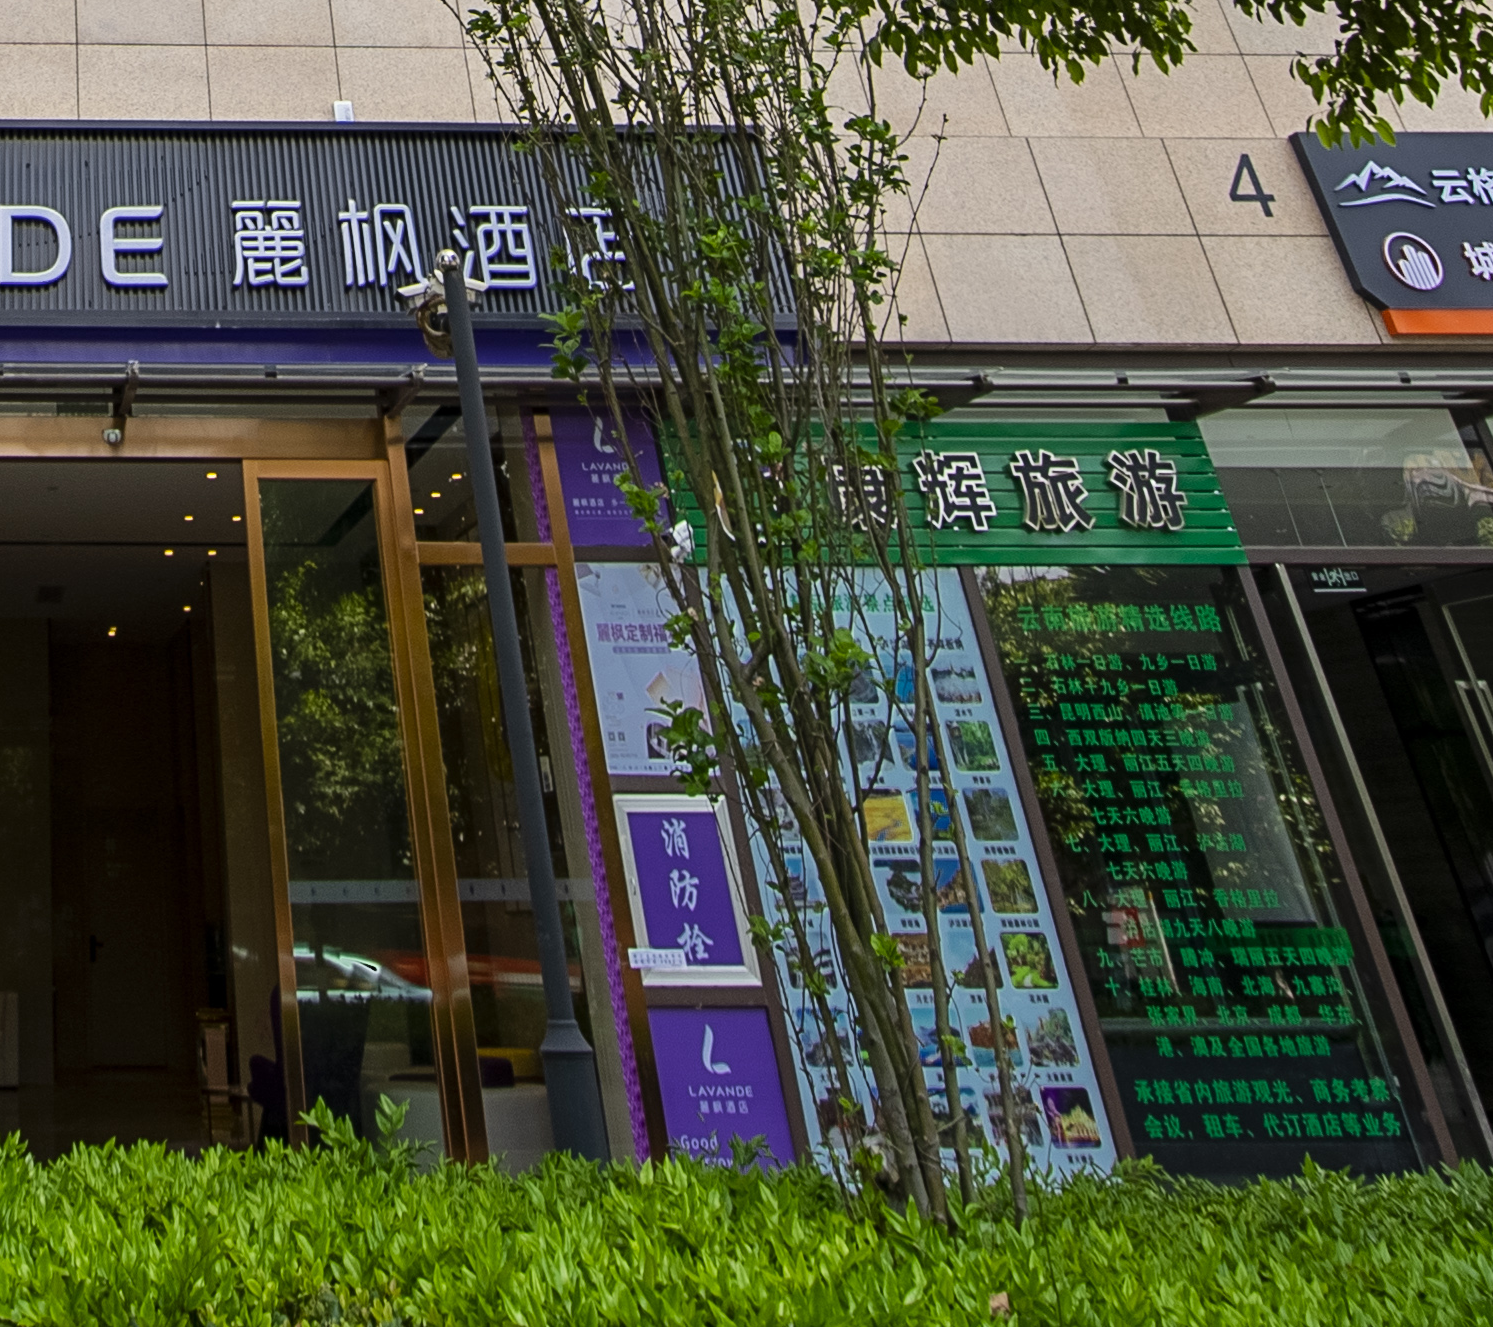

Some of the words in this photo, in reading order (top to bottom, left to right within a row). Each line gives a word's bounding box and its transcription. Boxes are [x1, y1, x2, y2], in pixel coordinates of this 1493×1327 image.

[1229, 153, 1275, 218] 4
[581, 462, 630, 472] LAVAND
[1017, 602, 1222, 632] 云南旅游精选线路
[596, 622, 673, 643] 麗枫定制福
[1091, 806, 1172, 826] 七天六晚游
[1106, 860, 1188, 881] 七天六晚游
[660, 817, 714, 962] 消防栓
[688, 1085, 754, 1097] LAVANDE
